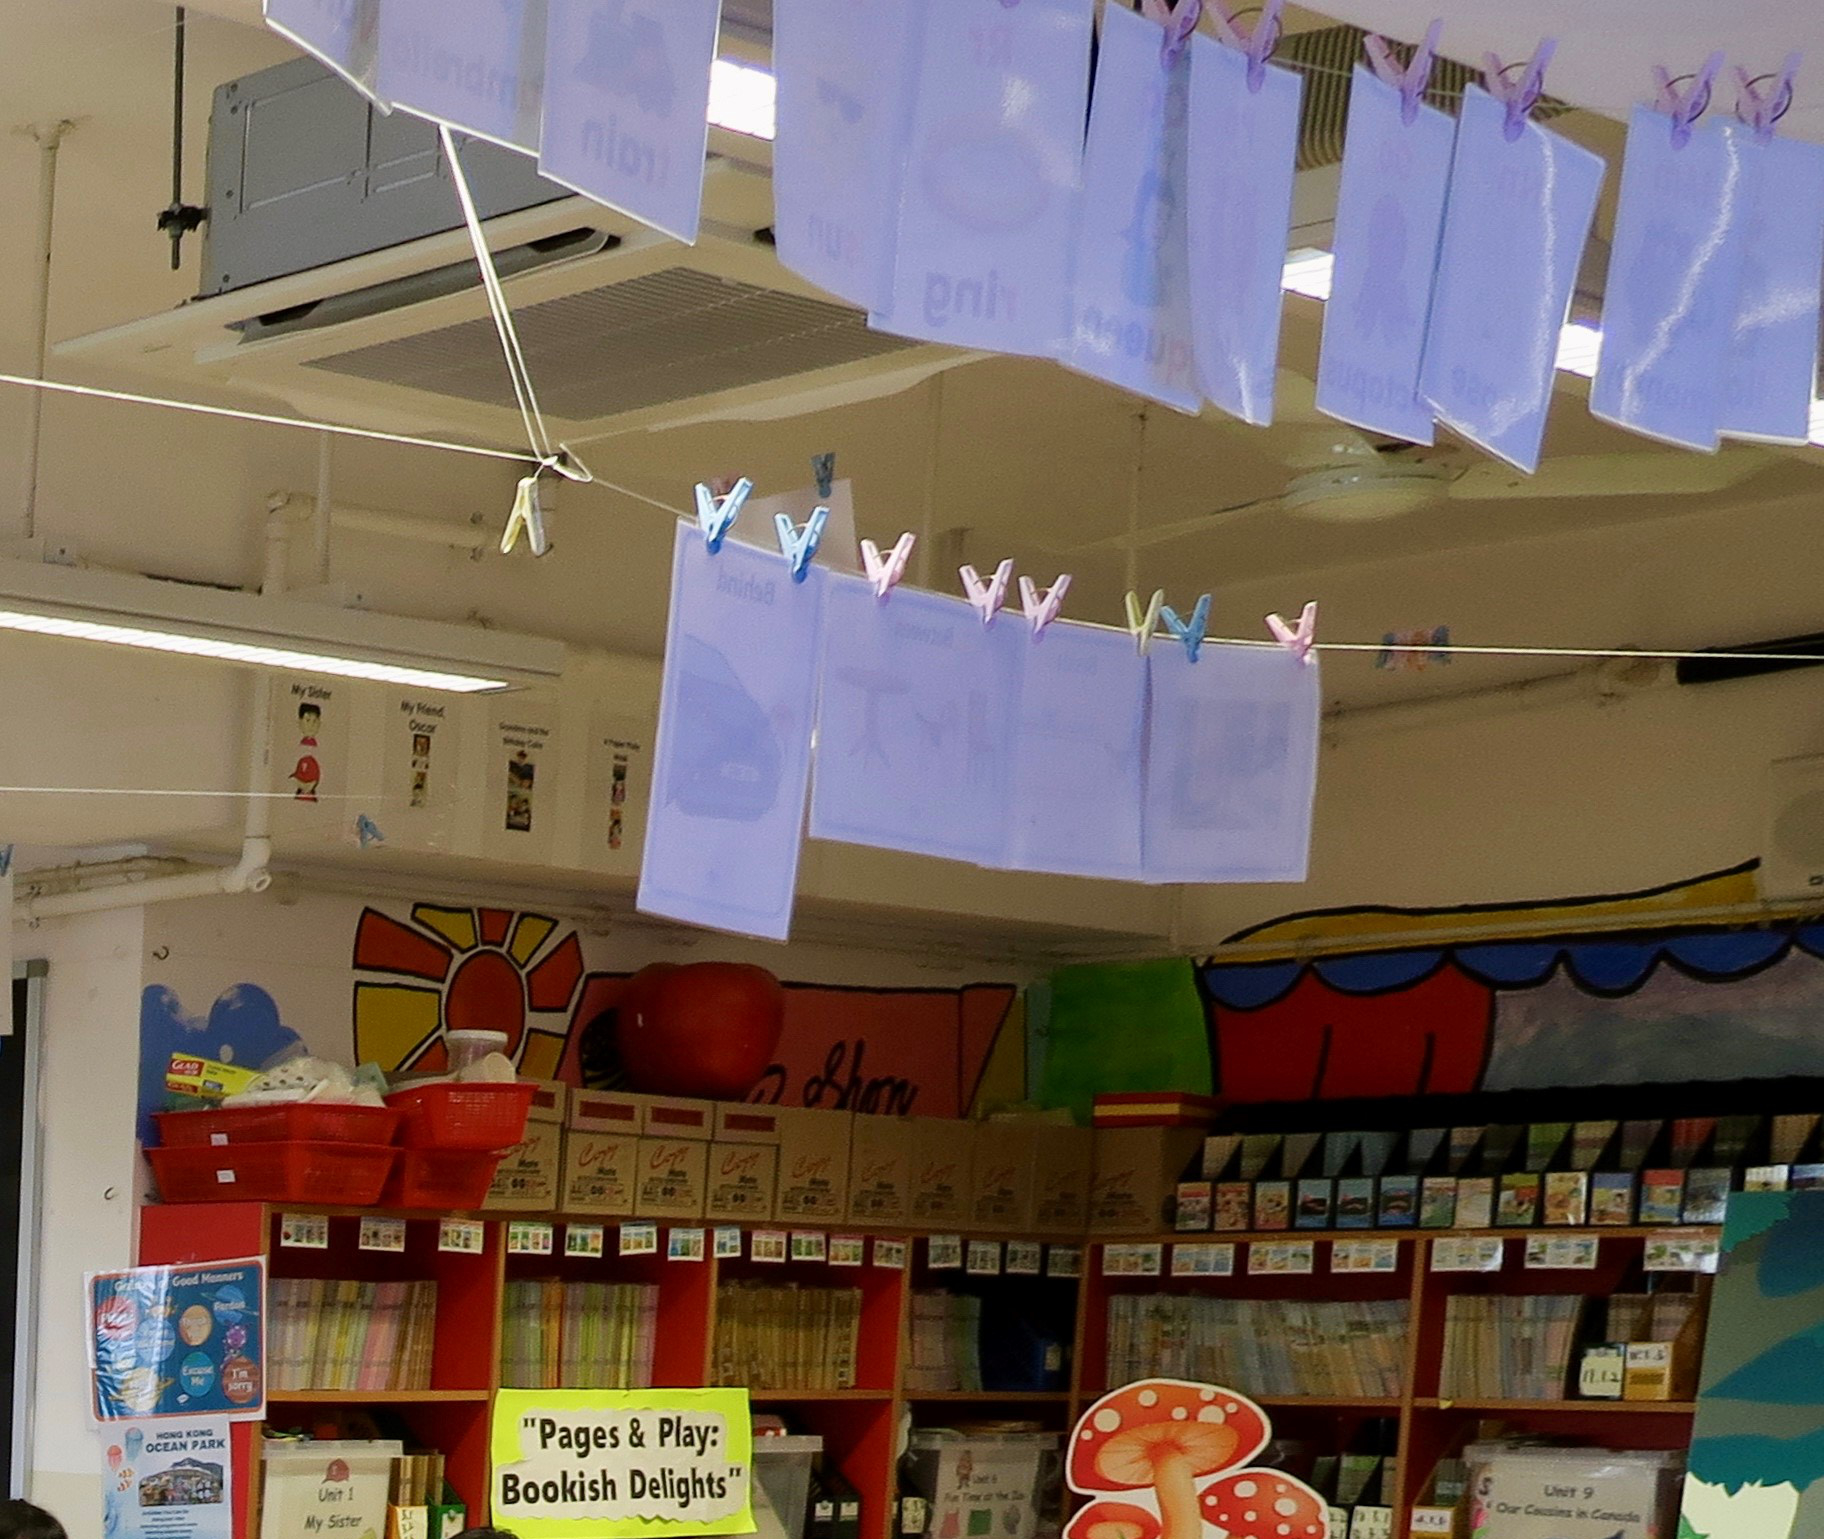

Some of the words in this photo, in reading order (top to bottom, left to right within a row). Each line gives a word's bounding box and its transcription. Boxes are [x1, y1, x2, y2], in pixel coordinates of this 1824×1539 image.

[307, 687, 332, 701] Sister
[172, 1273, 199, 1287] Good
[201, 1271, 244, 1284] Manners
[227, 1381, 252, 1393] sorry
[156, 1431, 183, 1440] HONG
[186, 1429, 213, 1439] KONG
[522, 1415, 620, 1458] "Pages
[628, 1419, 645, 1449] &
[658, 1415, 720, 1454] Play:
[146, 1441, 189, 1453] OCEAN
[192, 1438, 226, 1450] PARK
[502, 1465, 618, 1506] Bookish
[629, 1464, 742, 1509] Delights"
[1544, 1484, 1578, 1498] Unit
[1584, 1487, 1594, 1499] 9
[318, 1488, 342, 1502] Unit
[1496, 1502, 1520, 1514] Our
[1591, 1508, 1641, 1523] Canada
[304, 1515, 324, 1533] My
[328, 1514, 362, 1529] Sister
